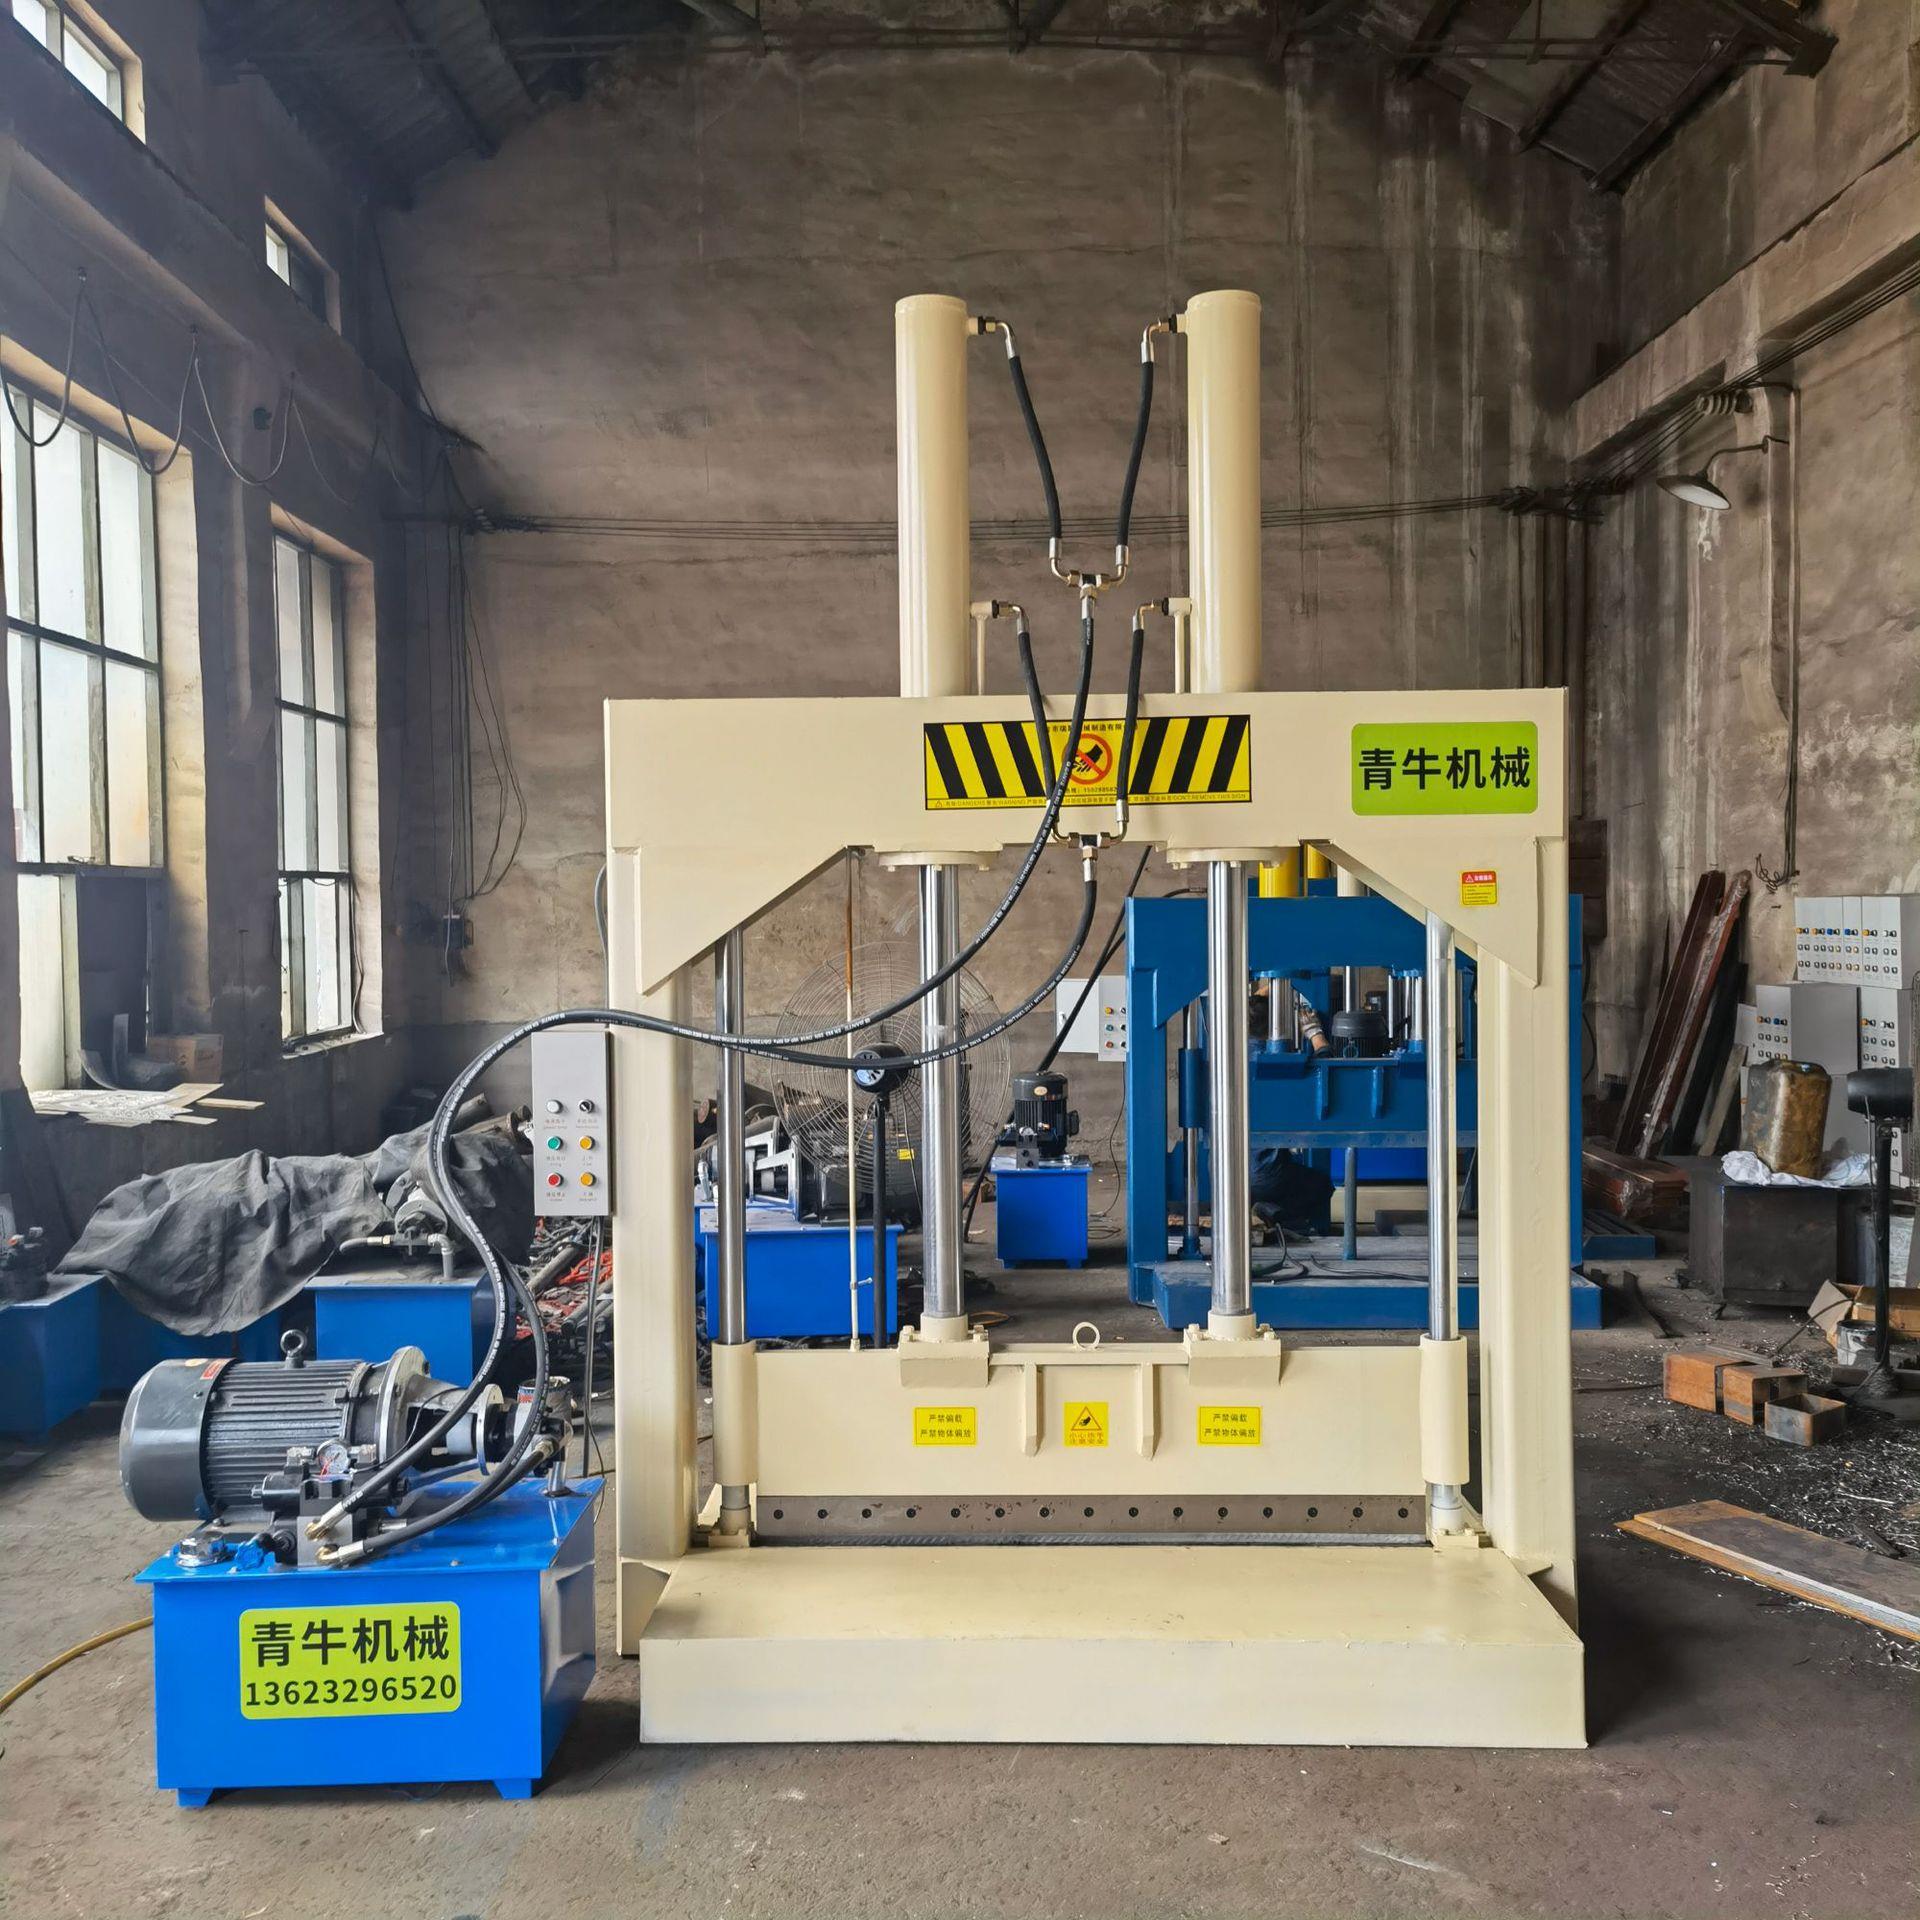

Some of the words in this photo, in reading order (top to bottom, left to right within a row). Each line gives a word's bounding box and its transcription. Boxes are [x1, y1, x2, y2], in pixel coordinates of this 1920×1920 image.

[1358, 746, 1530, 790] 青牛机械
[251, 1615, 450, 1668] 青牛机械
[246, 1675, 457, 1707] 13623296520
